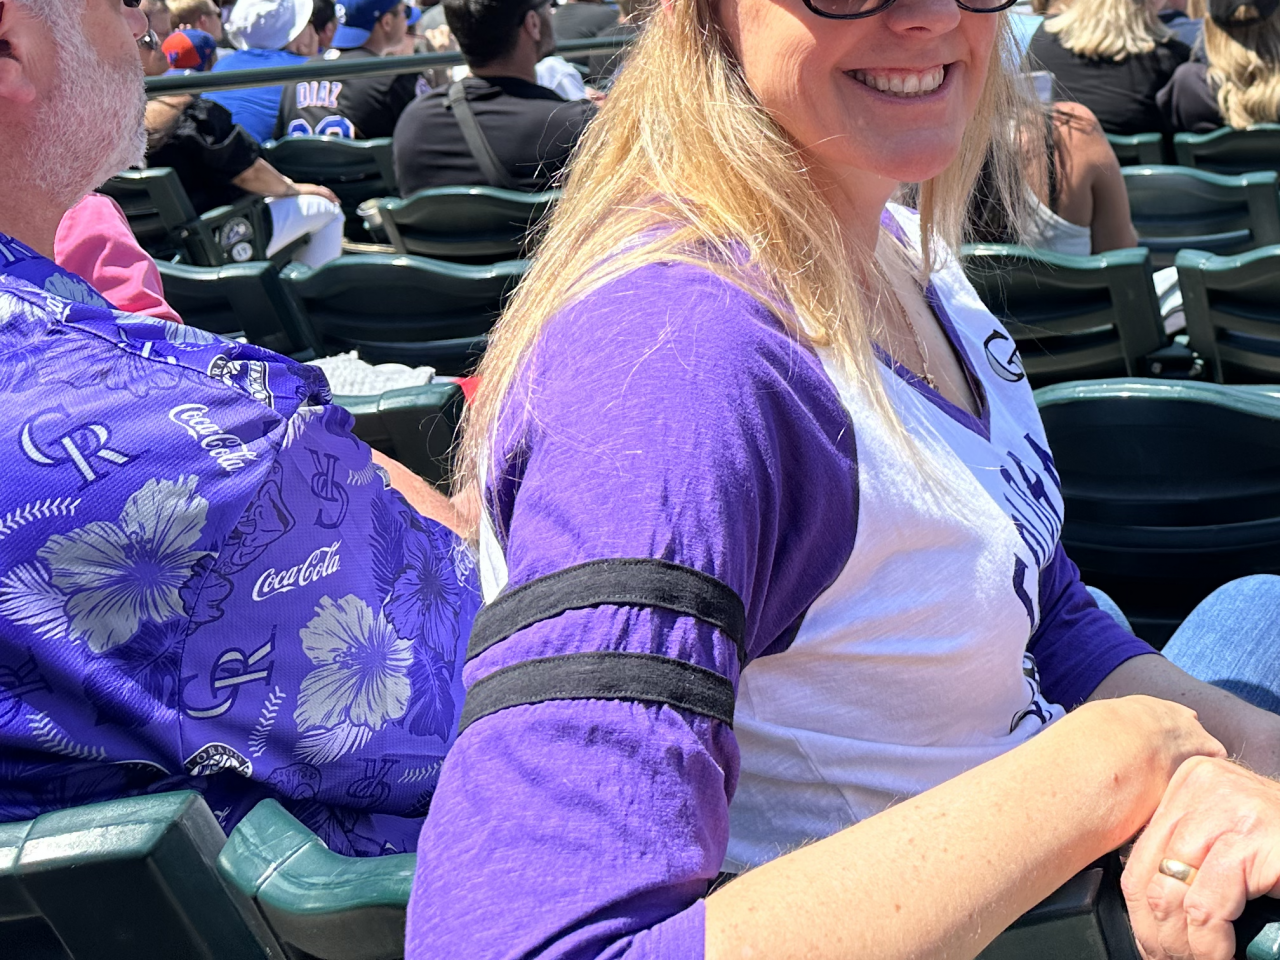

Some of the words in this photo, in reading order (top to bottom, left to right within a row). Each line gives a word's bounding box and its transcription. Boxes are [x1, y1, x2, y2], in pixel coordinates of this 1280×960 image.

[296, 80, 342, 109] DIAZ
[18, 403, 151, 492] CR
[252, 539, 342, 601] Coca-Cola
[179, 624, 277, 720] CR
[186, 745, 242, 770] LORADO
